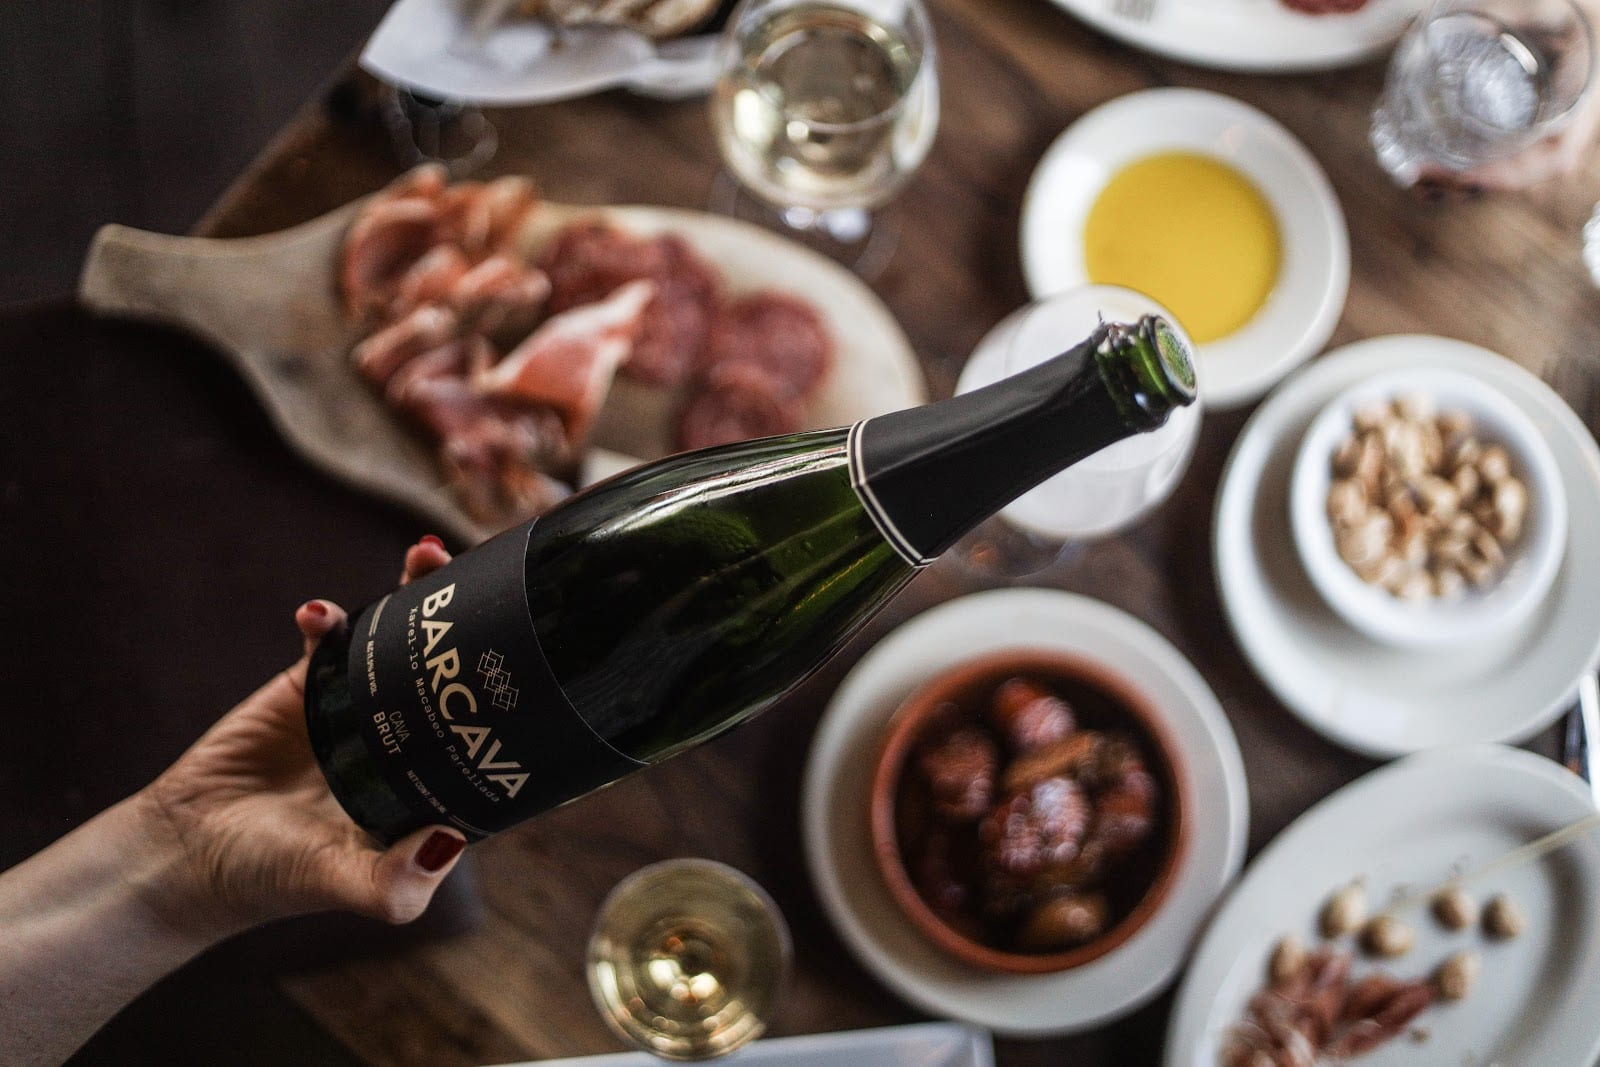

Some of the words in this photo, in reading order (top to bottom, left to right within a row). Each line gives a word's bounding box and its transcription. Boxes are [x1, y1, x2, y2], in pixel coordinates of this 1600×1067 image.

[389, 710, 411, 743] CAVA
[422, 583, 530, 798] BARCAVA
[373, 711, 402, 755] BRUT
[416, 678, 445, 738] Macabeo
[446, 745, 500, 802] Parellada
